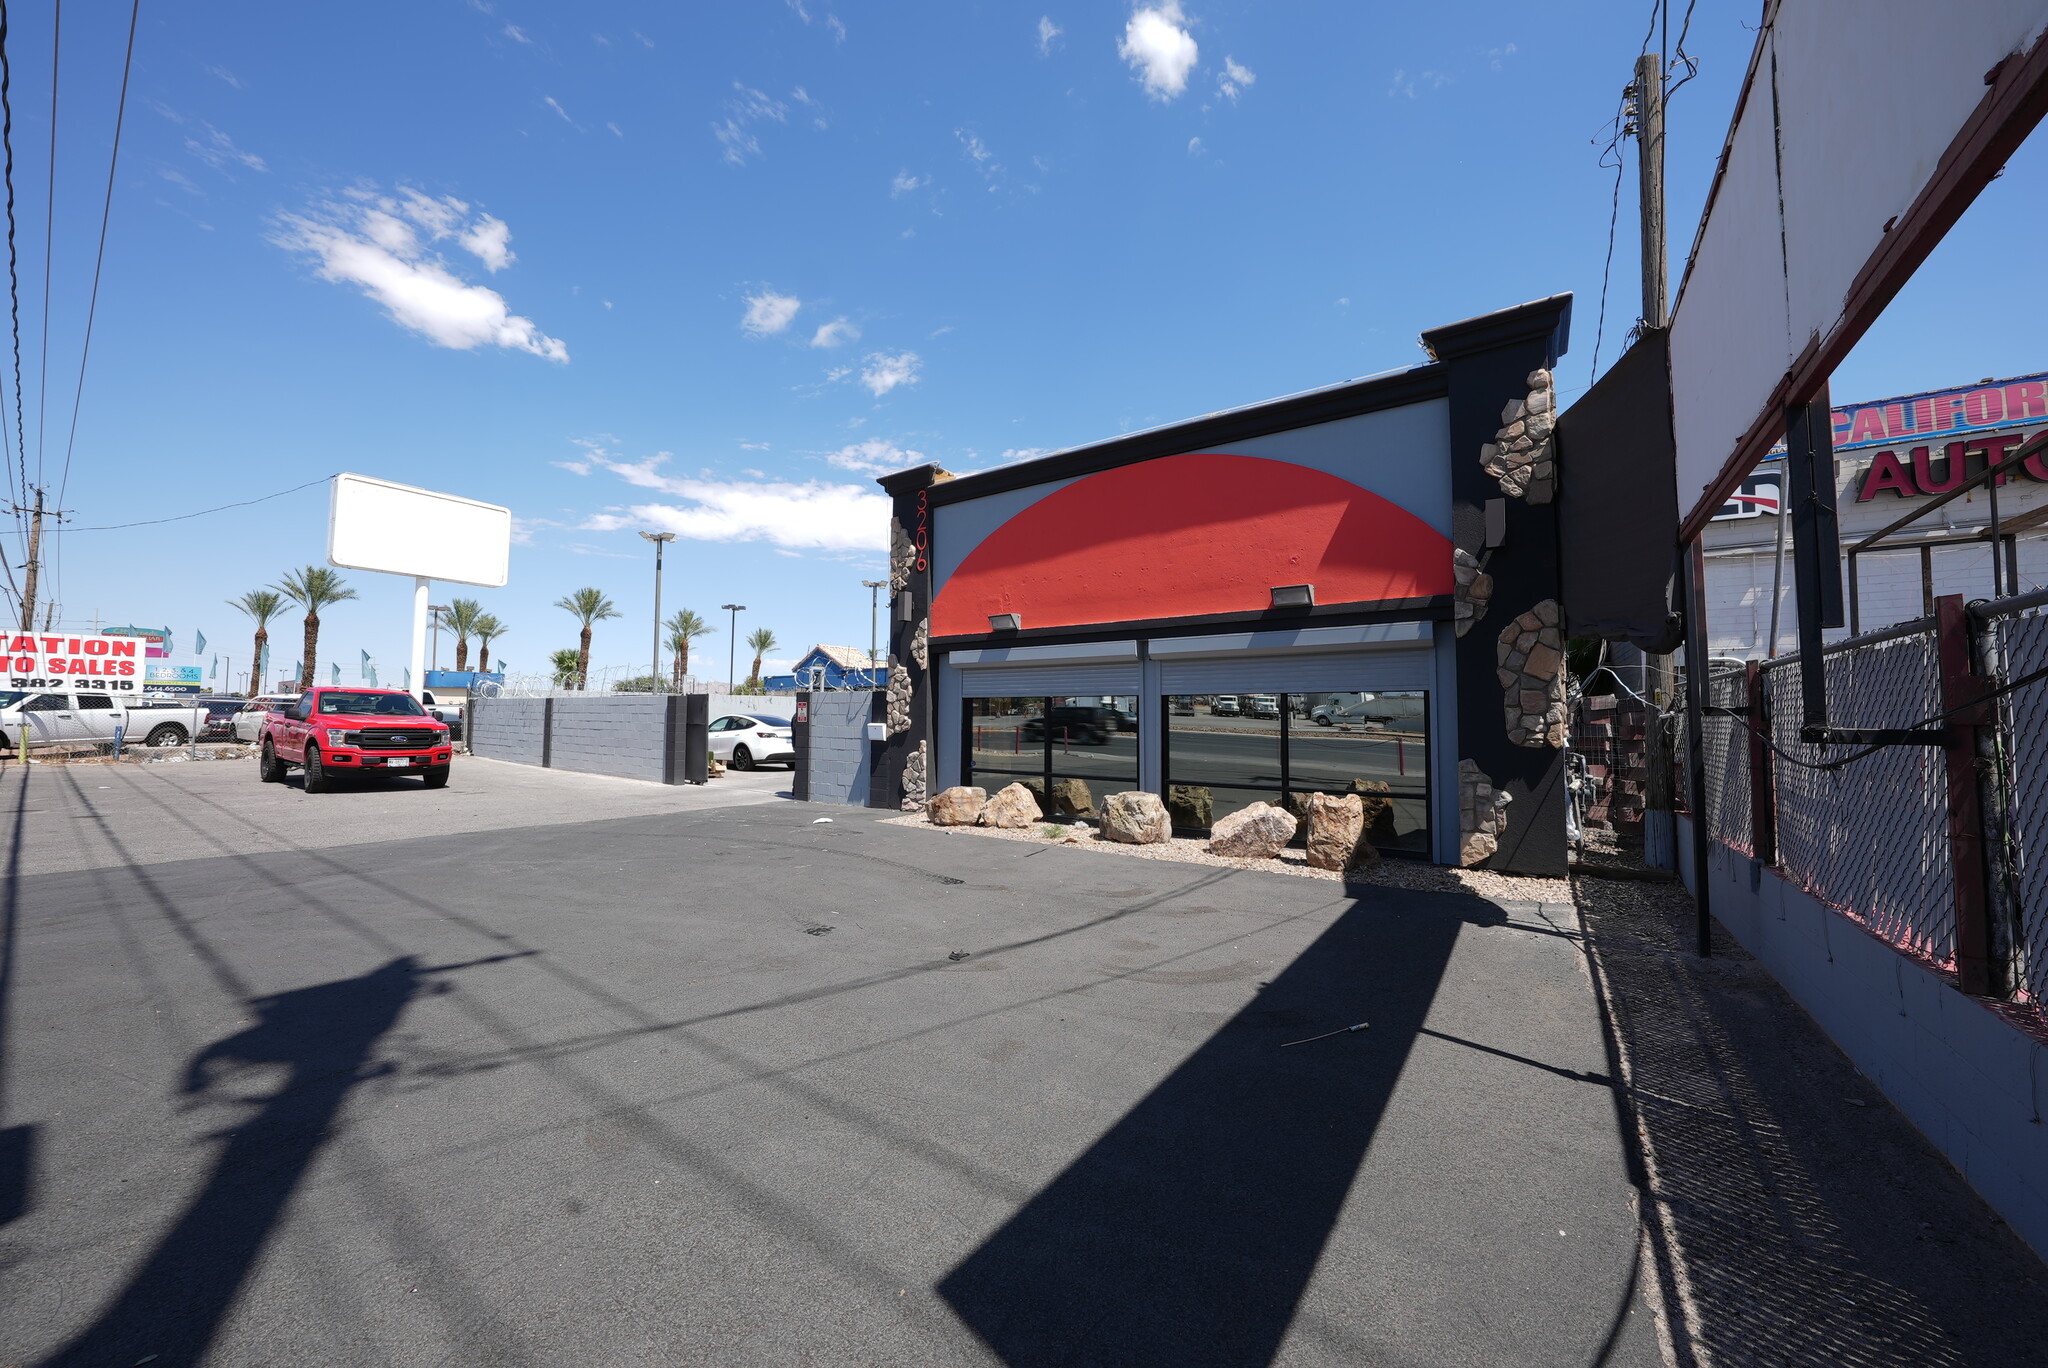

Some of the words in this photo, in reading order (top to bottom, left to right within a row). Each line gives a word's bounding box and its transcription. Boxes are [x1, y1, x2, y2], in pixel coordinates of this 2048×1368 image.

[1831, 382, 2048, 446] CALIFOR
[916, 490, 928, 572] 3206
[48, 658, 135, 676] SALES
[149, 672, 199, 680] BEDROOMS
[11, 678, 64, 688] 382
[74, 679, 134, 690] 3315
